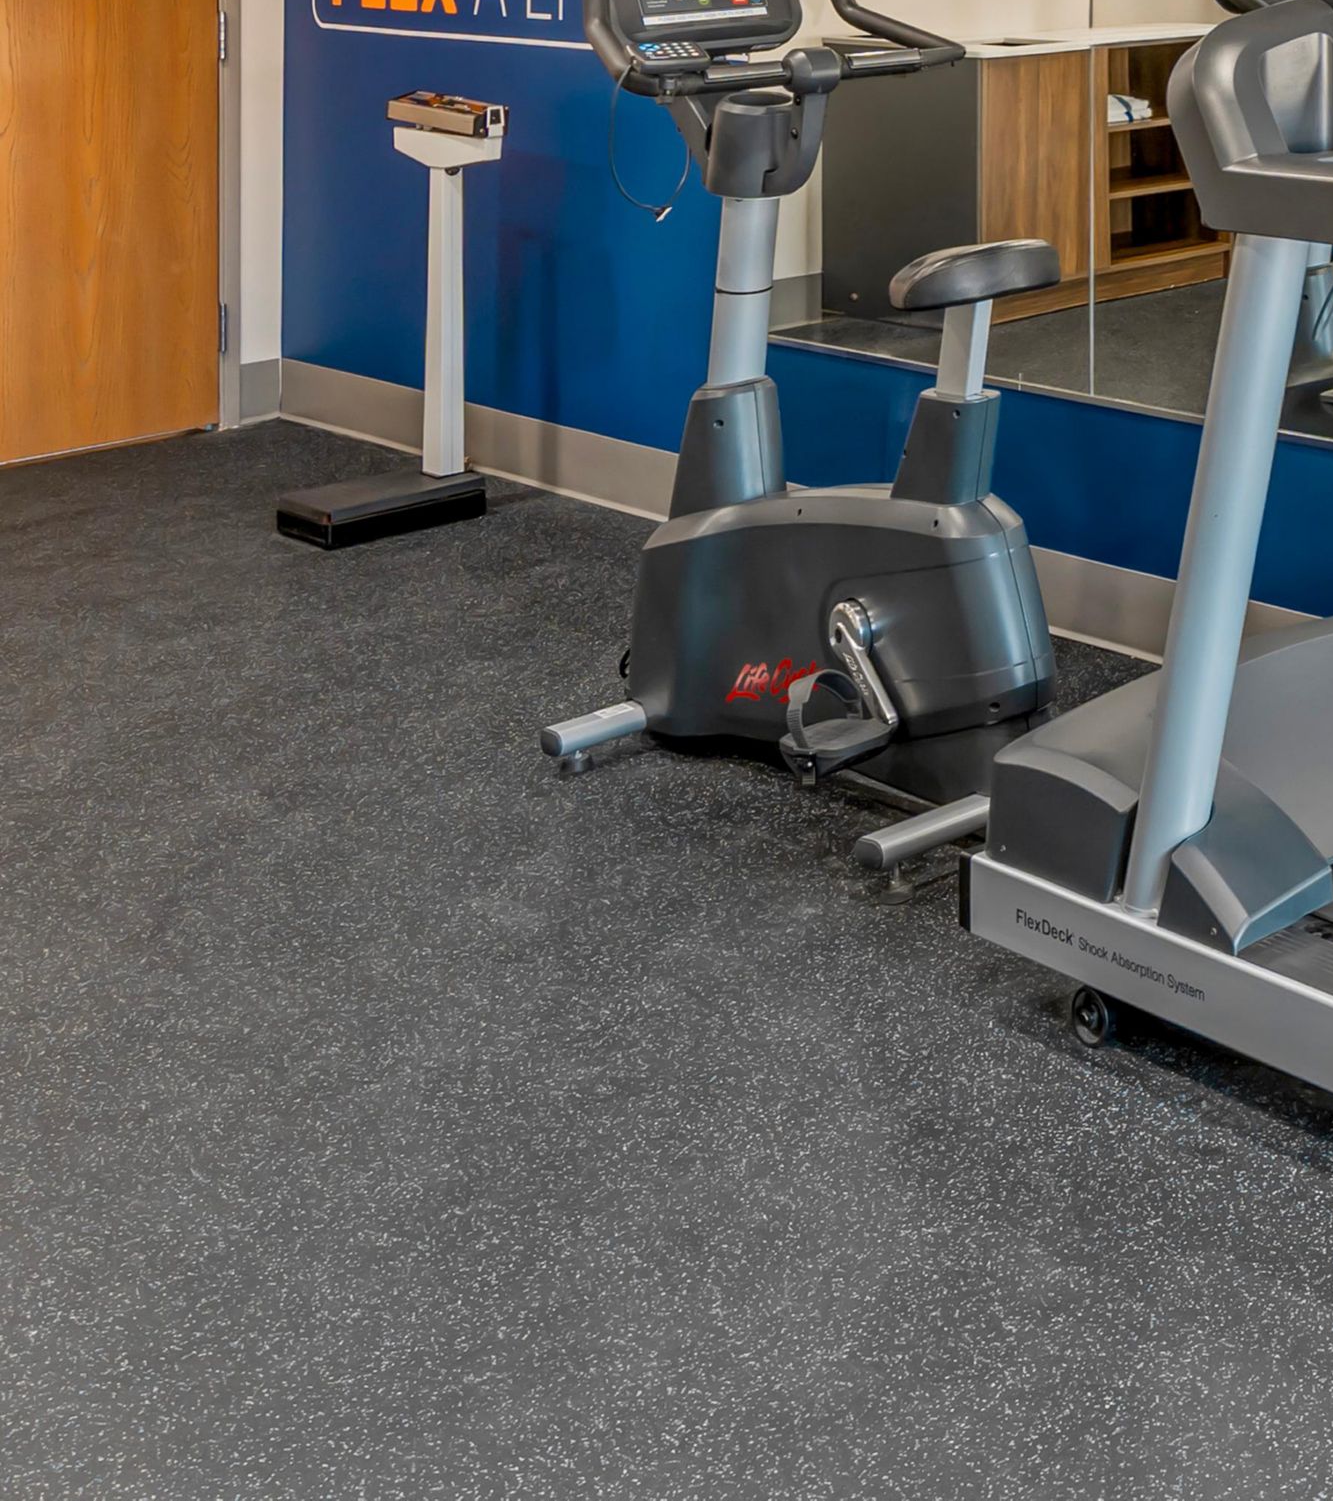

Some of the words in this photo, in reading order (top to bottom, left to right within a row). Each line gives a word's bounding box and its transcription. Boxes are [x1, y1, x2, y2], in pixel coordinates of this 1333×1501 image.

[725, 662, 771, 703] Life
[1015, 908, 1074, 947] FlexDeck
[1078, 936, 1109, 961] Shock
[1110, 951, 1165, 985] Absorption
[1167, 973, 1205, 1001] System
